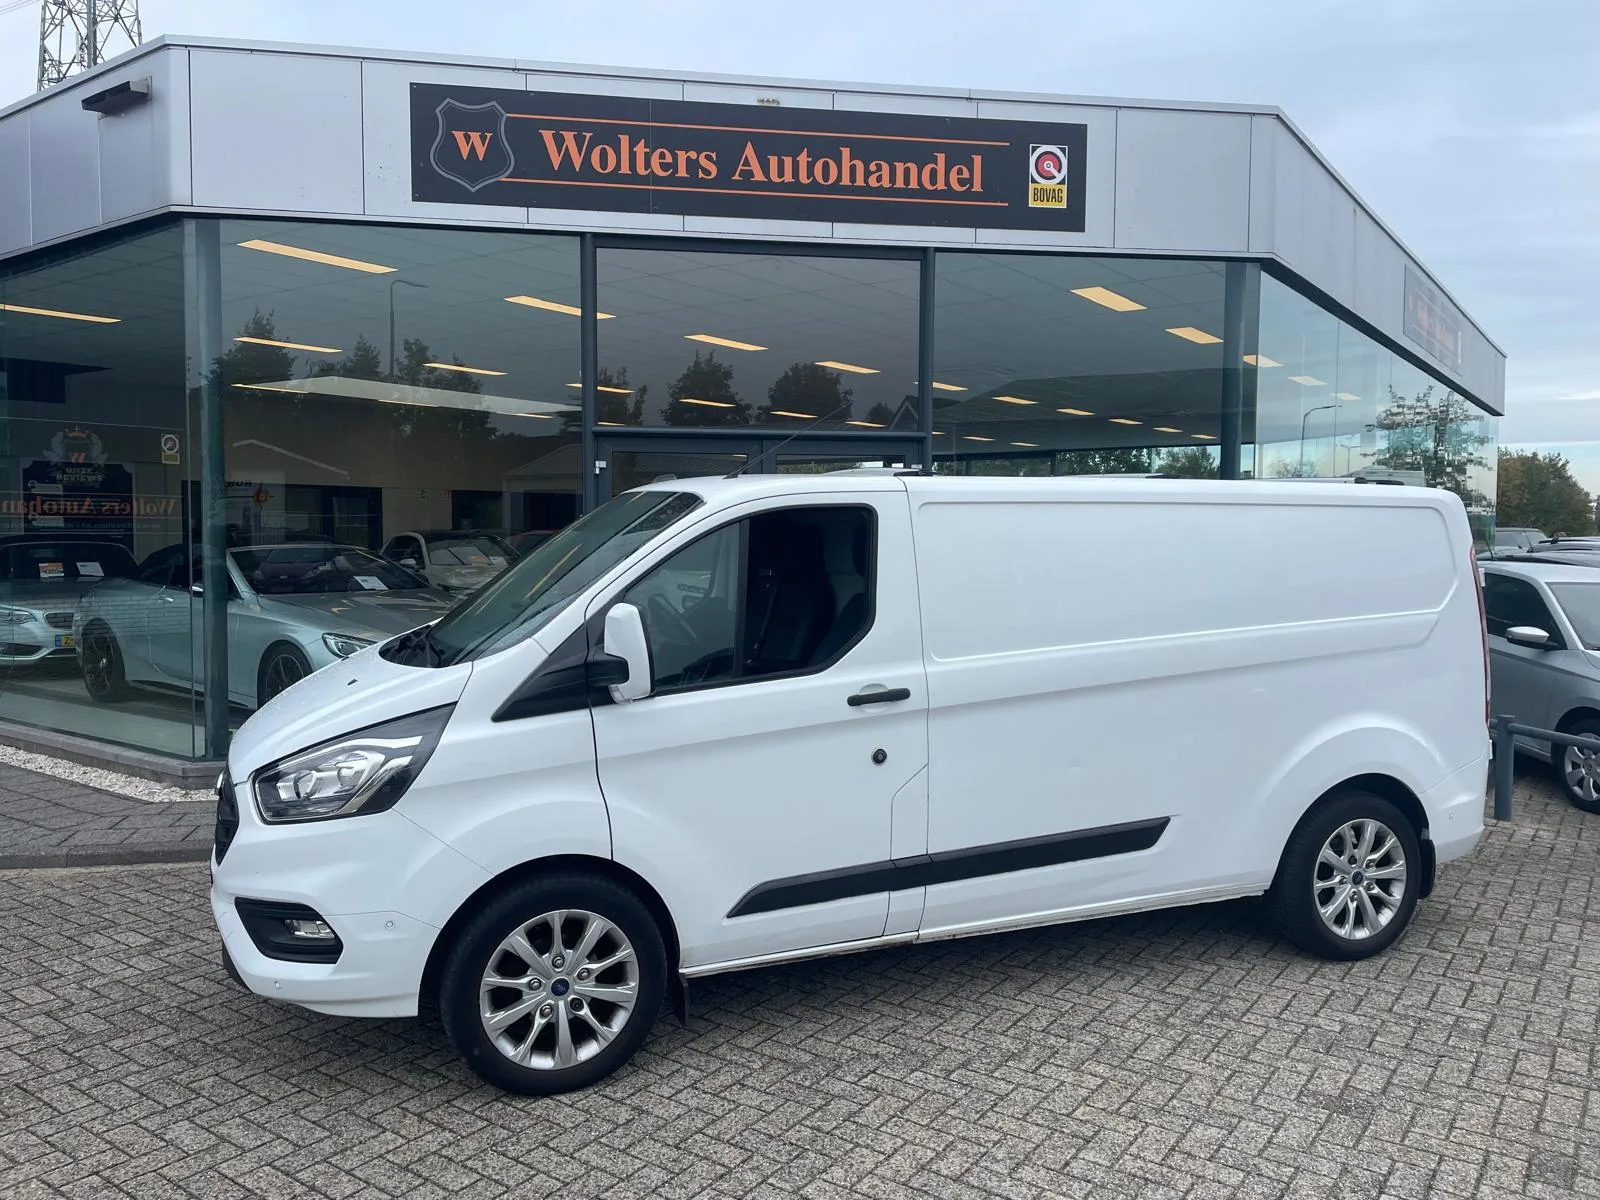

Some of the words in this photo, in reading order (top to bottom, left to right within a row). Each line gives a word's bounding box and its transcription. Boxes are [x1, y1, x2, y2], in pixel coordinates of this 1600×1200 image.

[451, 130, 494, 161] W
[538, 129, 718, 180] Wolters
[730, 140, 985, 193] Autohandel
[1032, 187, 1064, 205] BOVAG
